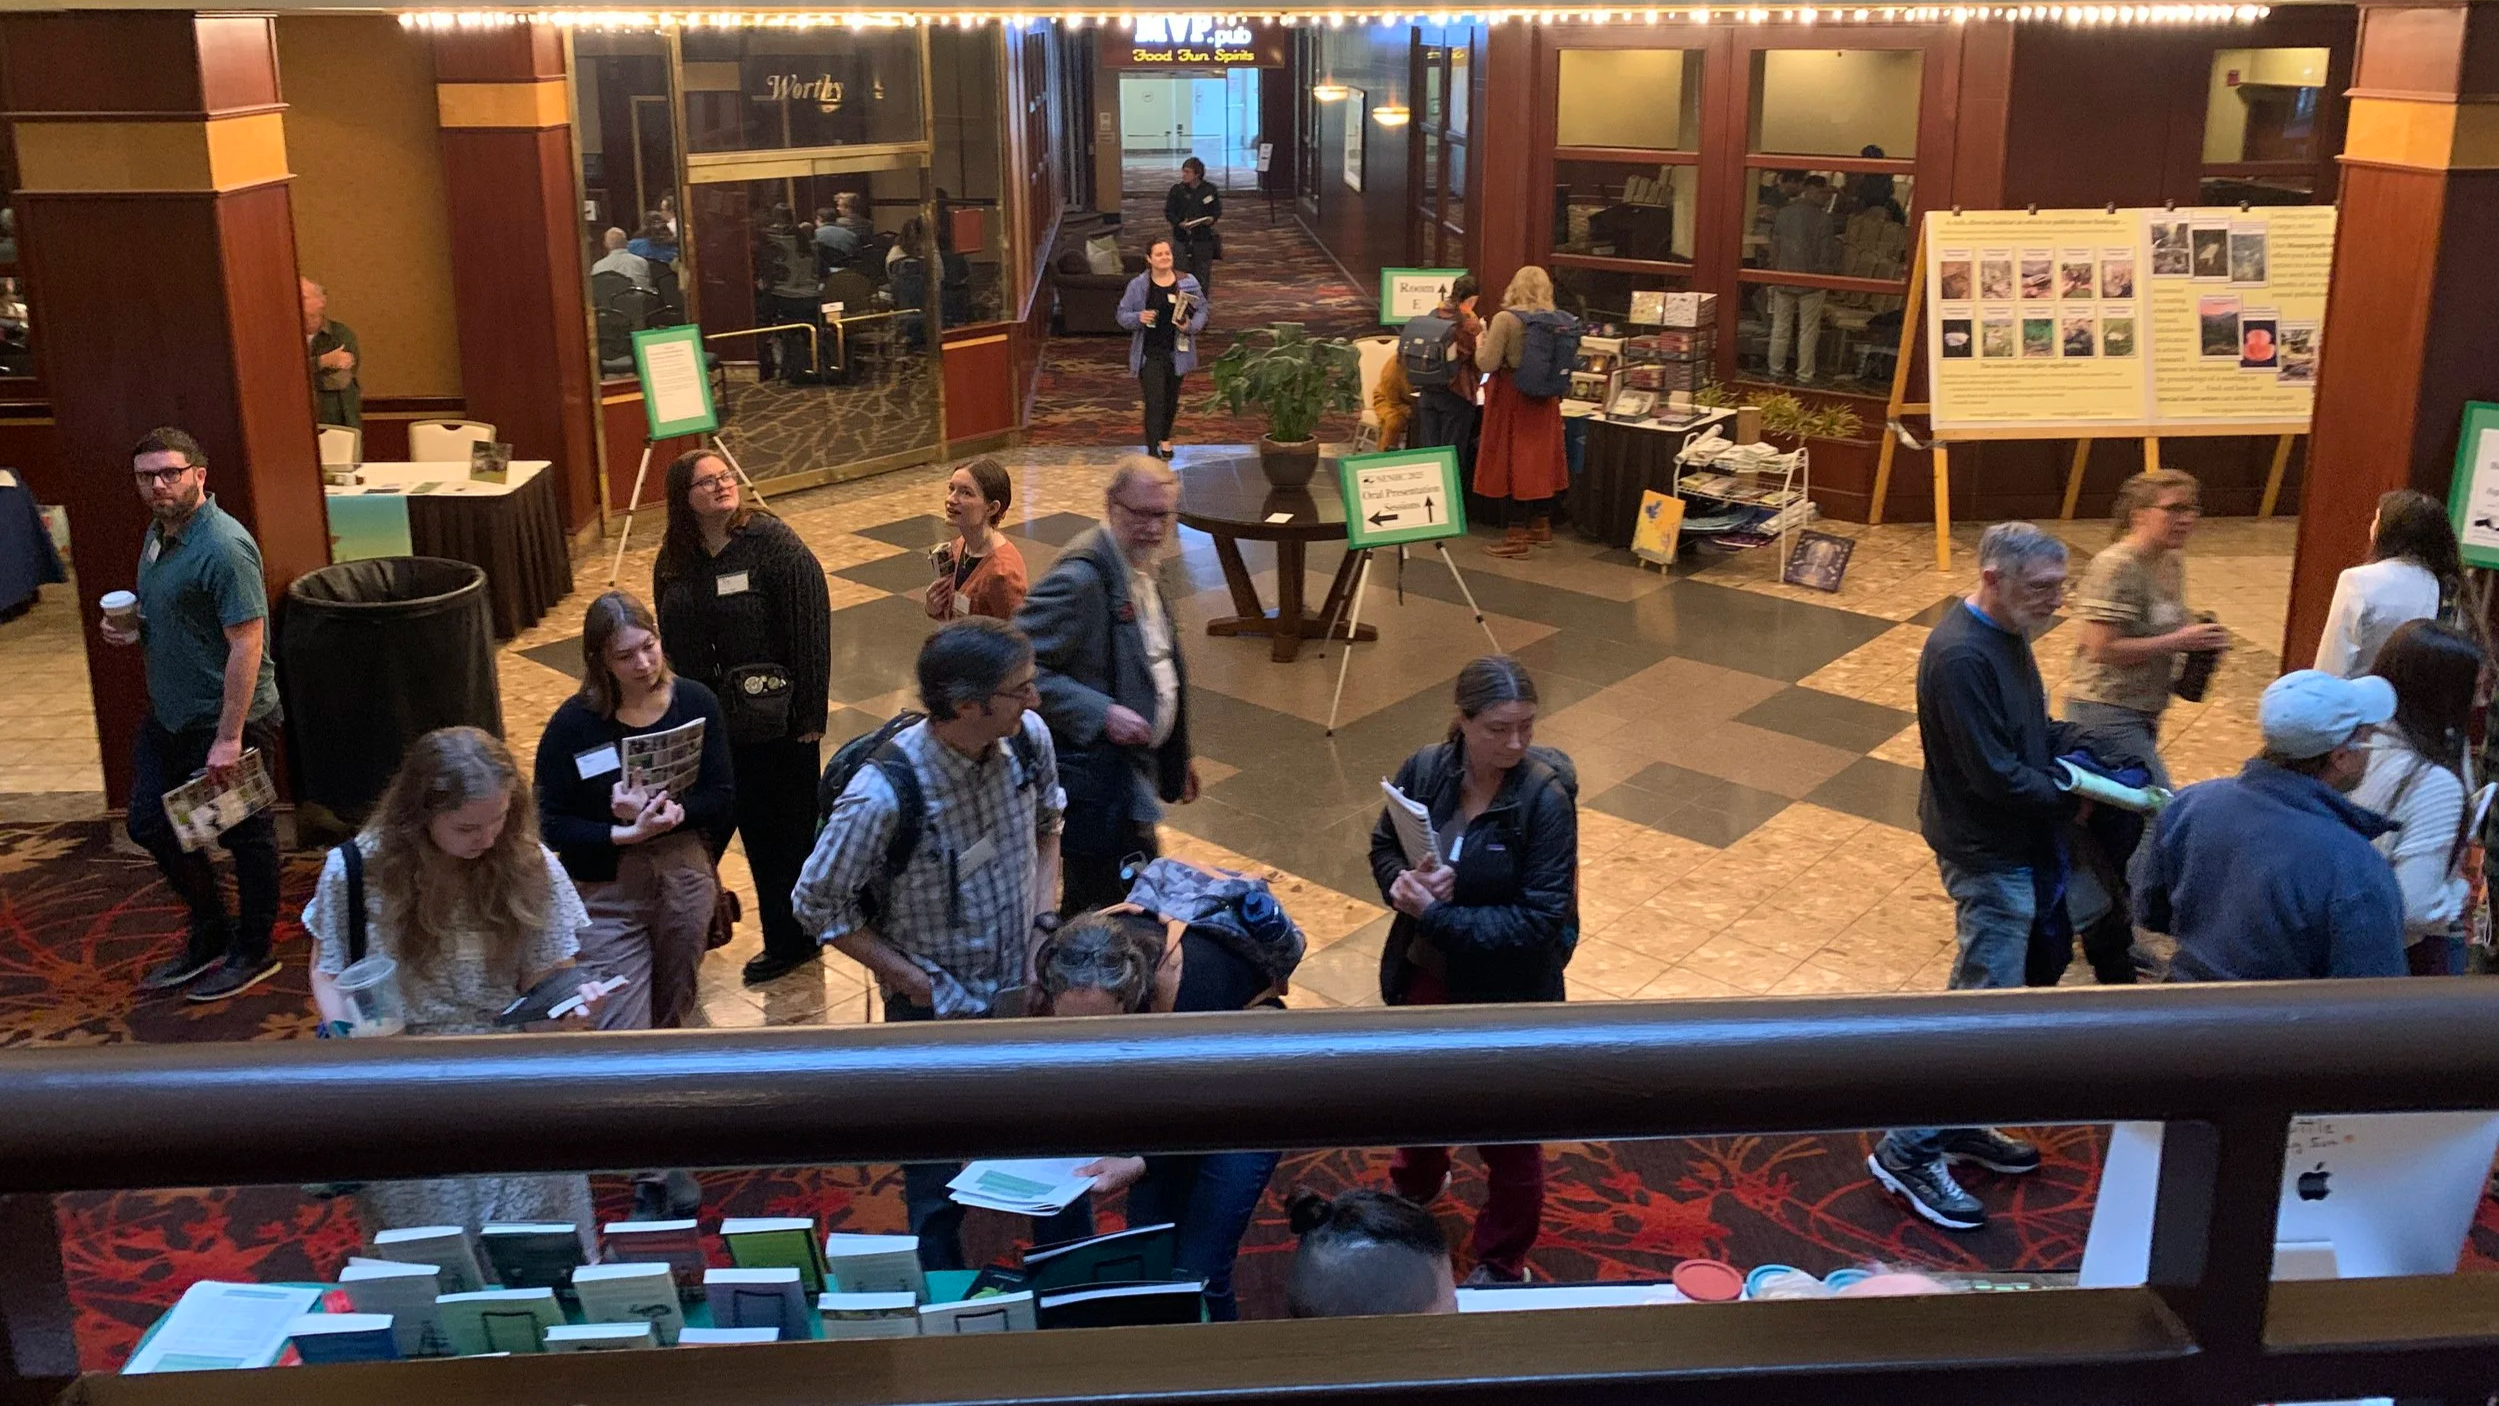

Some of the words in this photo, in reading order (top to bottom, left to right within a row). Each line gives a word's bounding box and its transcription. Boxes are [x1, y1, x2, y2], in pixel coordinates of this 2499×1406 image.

[1132, 49, 1173, 62] Food
[1177, 49, 1210, 62] Fun
[1214, 49, 1255, 63] Spirits
[766, 74, 844, 101] Worthy
[1400, 282, 1435, 293] Room
[1412, 299, 1421, 310] E
[1362, 489, 1384, 500] Oral
[1386, 484, 1441, 498] Presentation
[1384, 501, 1422, 512] Sessions
